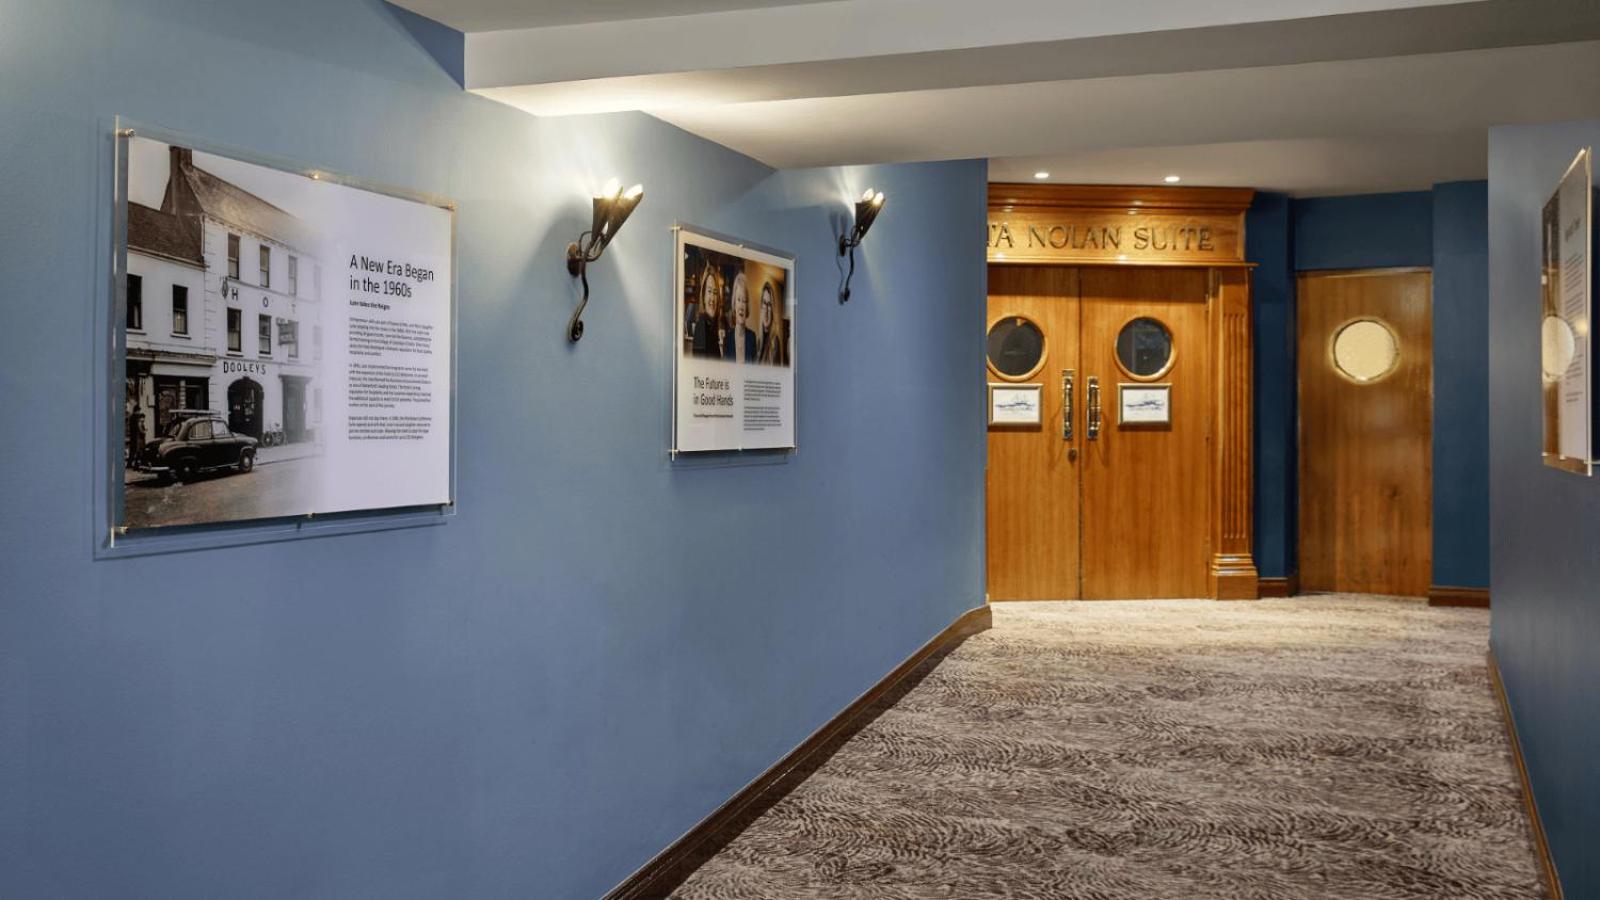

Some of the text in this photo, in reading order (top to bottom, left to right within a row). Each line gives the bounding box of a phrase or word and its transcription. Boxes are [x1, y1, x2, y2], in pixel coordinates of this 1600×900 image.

[1028, 224, 1121, 250] NOLAN
[1134, 226, 1214, 251] SUITE
[350, 254, 434, 283] A New Era Began
[350, 275, 412, 298] in the 1960s
[223, 361, 266, 375] DOOLEYS
[694, 376, 730, 390] The Future is
[694, 393, 734, 406] in Good Hands
